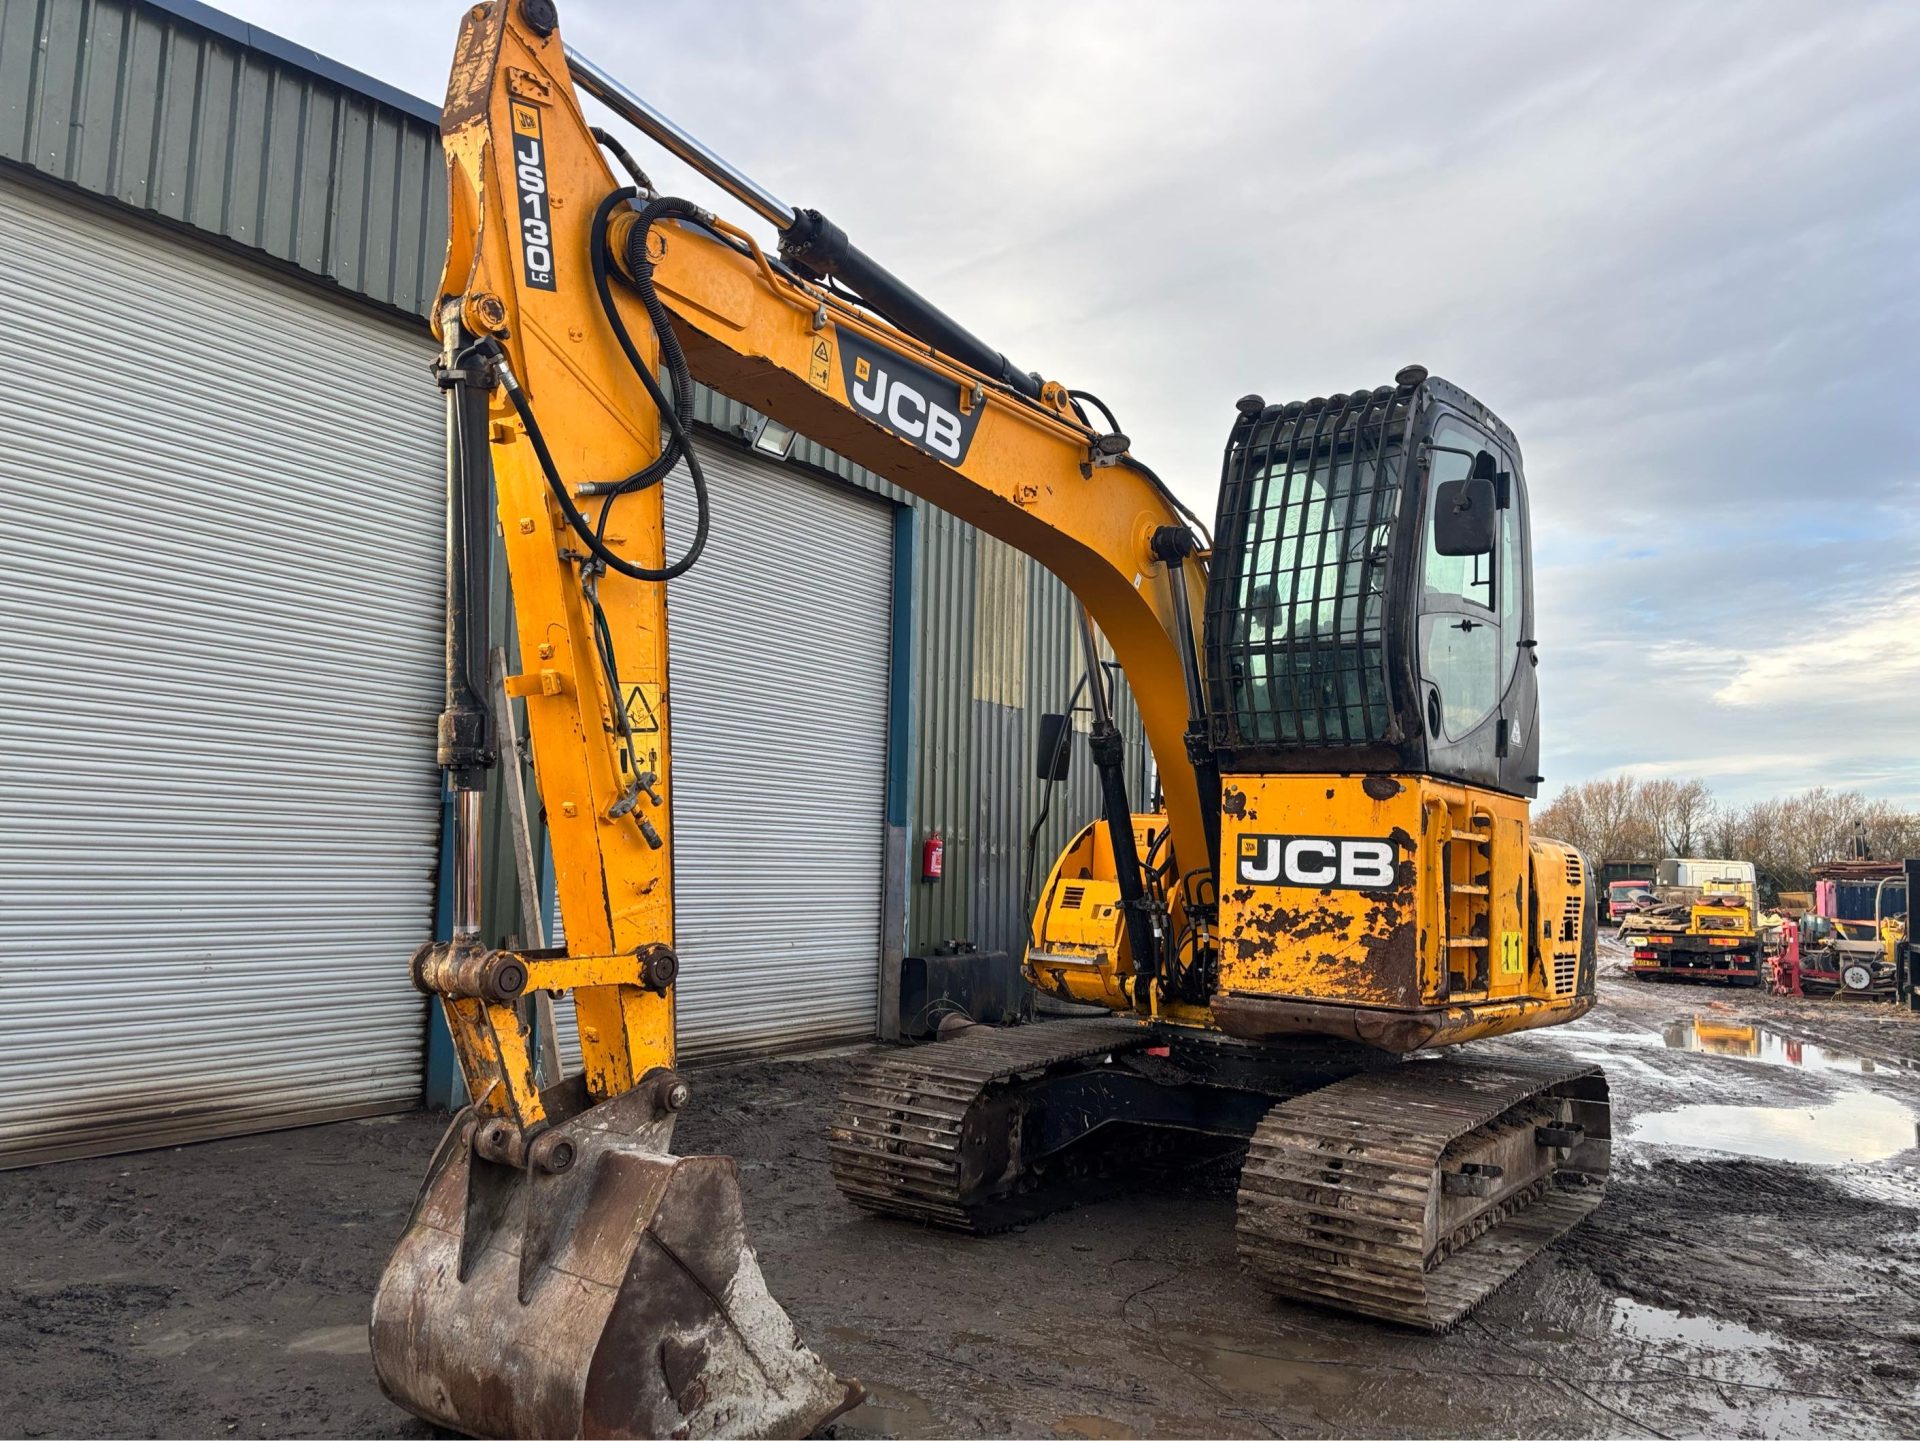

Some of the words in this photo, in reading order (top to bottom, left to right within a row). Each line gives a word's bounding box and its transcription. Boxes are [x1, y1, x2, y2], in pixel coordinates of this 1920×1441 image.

[517, 140, 551, 273] JS130
[531, 271, 550, 283] LC
[853, 369, 962, 460] JCB
[1241, 839, 1395, 887] JCB
[1504, 935, 1520, 970] 11
